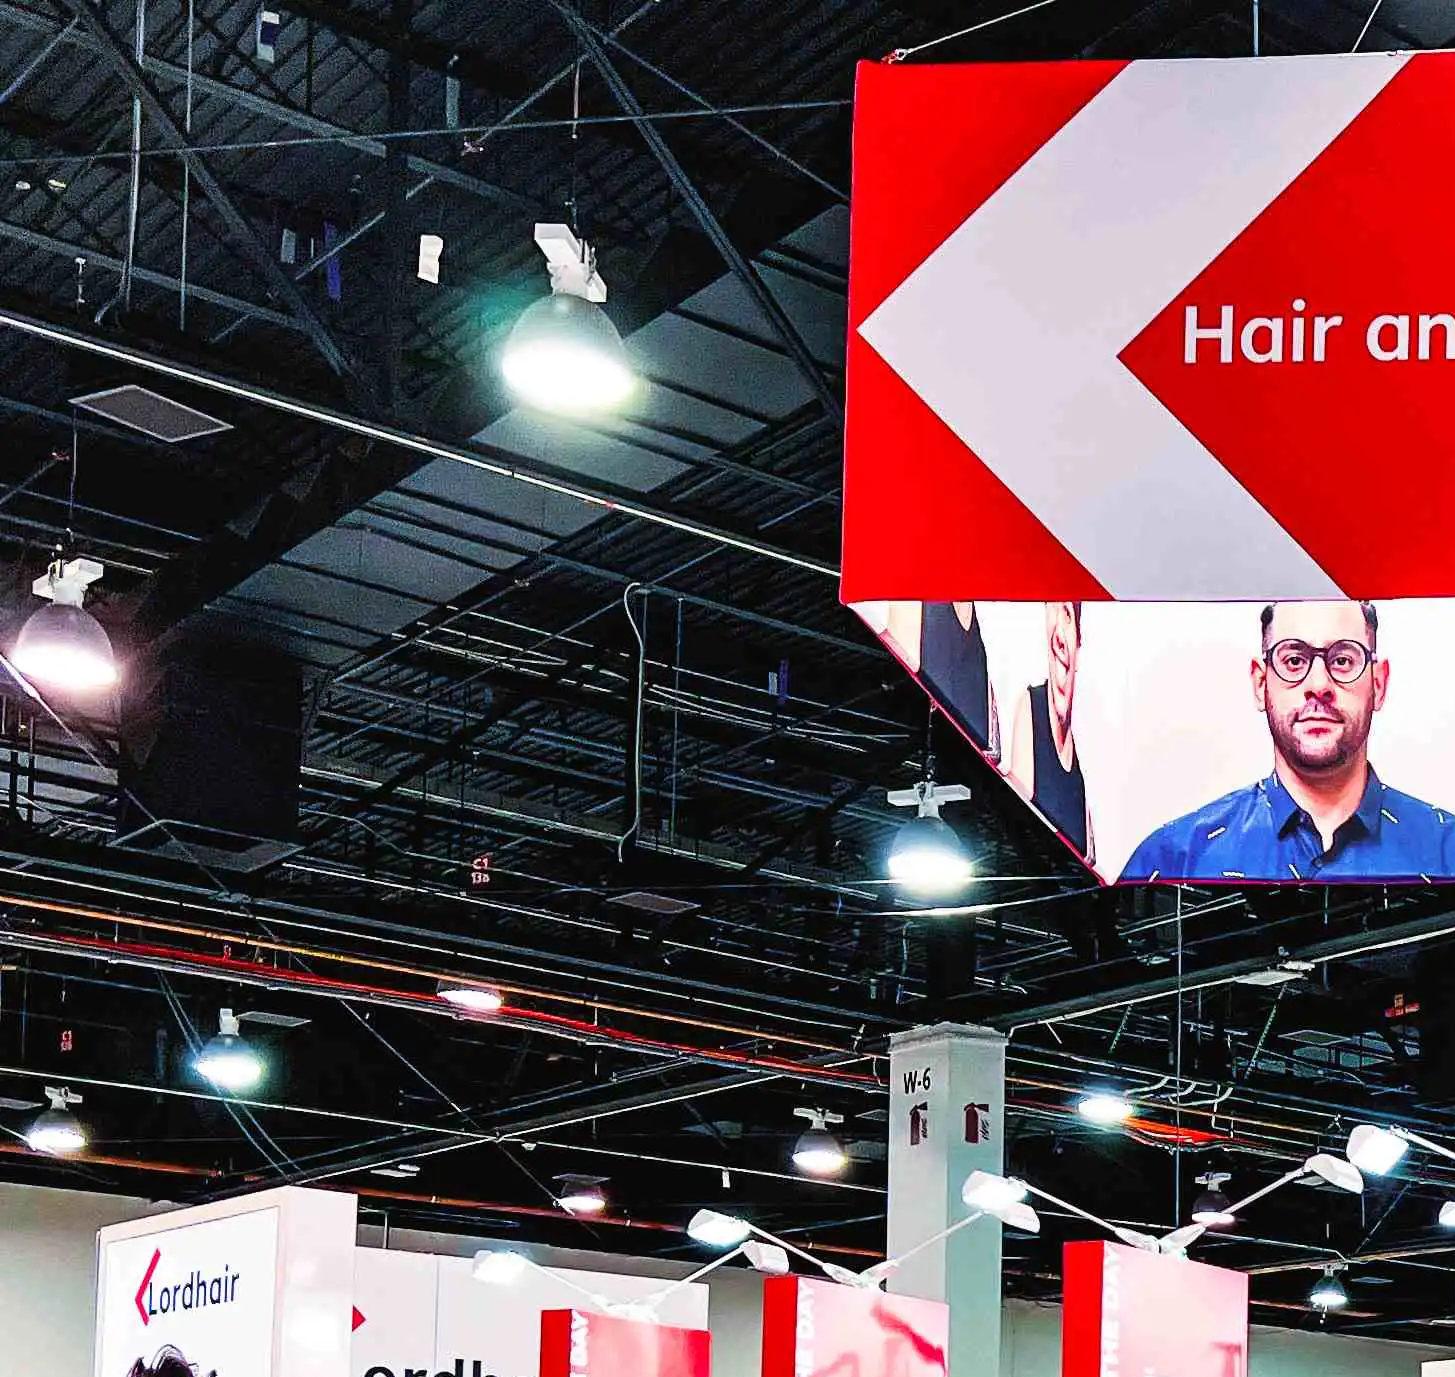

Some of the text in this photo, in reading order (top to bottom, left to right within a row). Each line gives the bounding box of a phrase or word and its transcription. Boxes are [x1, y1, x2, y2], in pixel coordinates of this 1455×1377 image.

[1183, 298, 1343, 364] Hair
[904, 1068, 931, 1095] W-6
[148, 1263, 240, 1316] Lordhair
